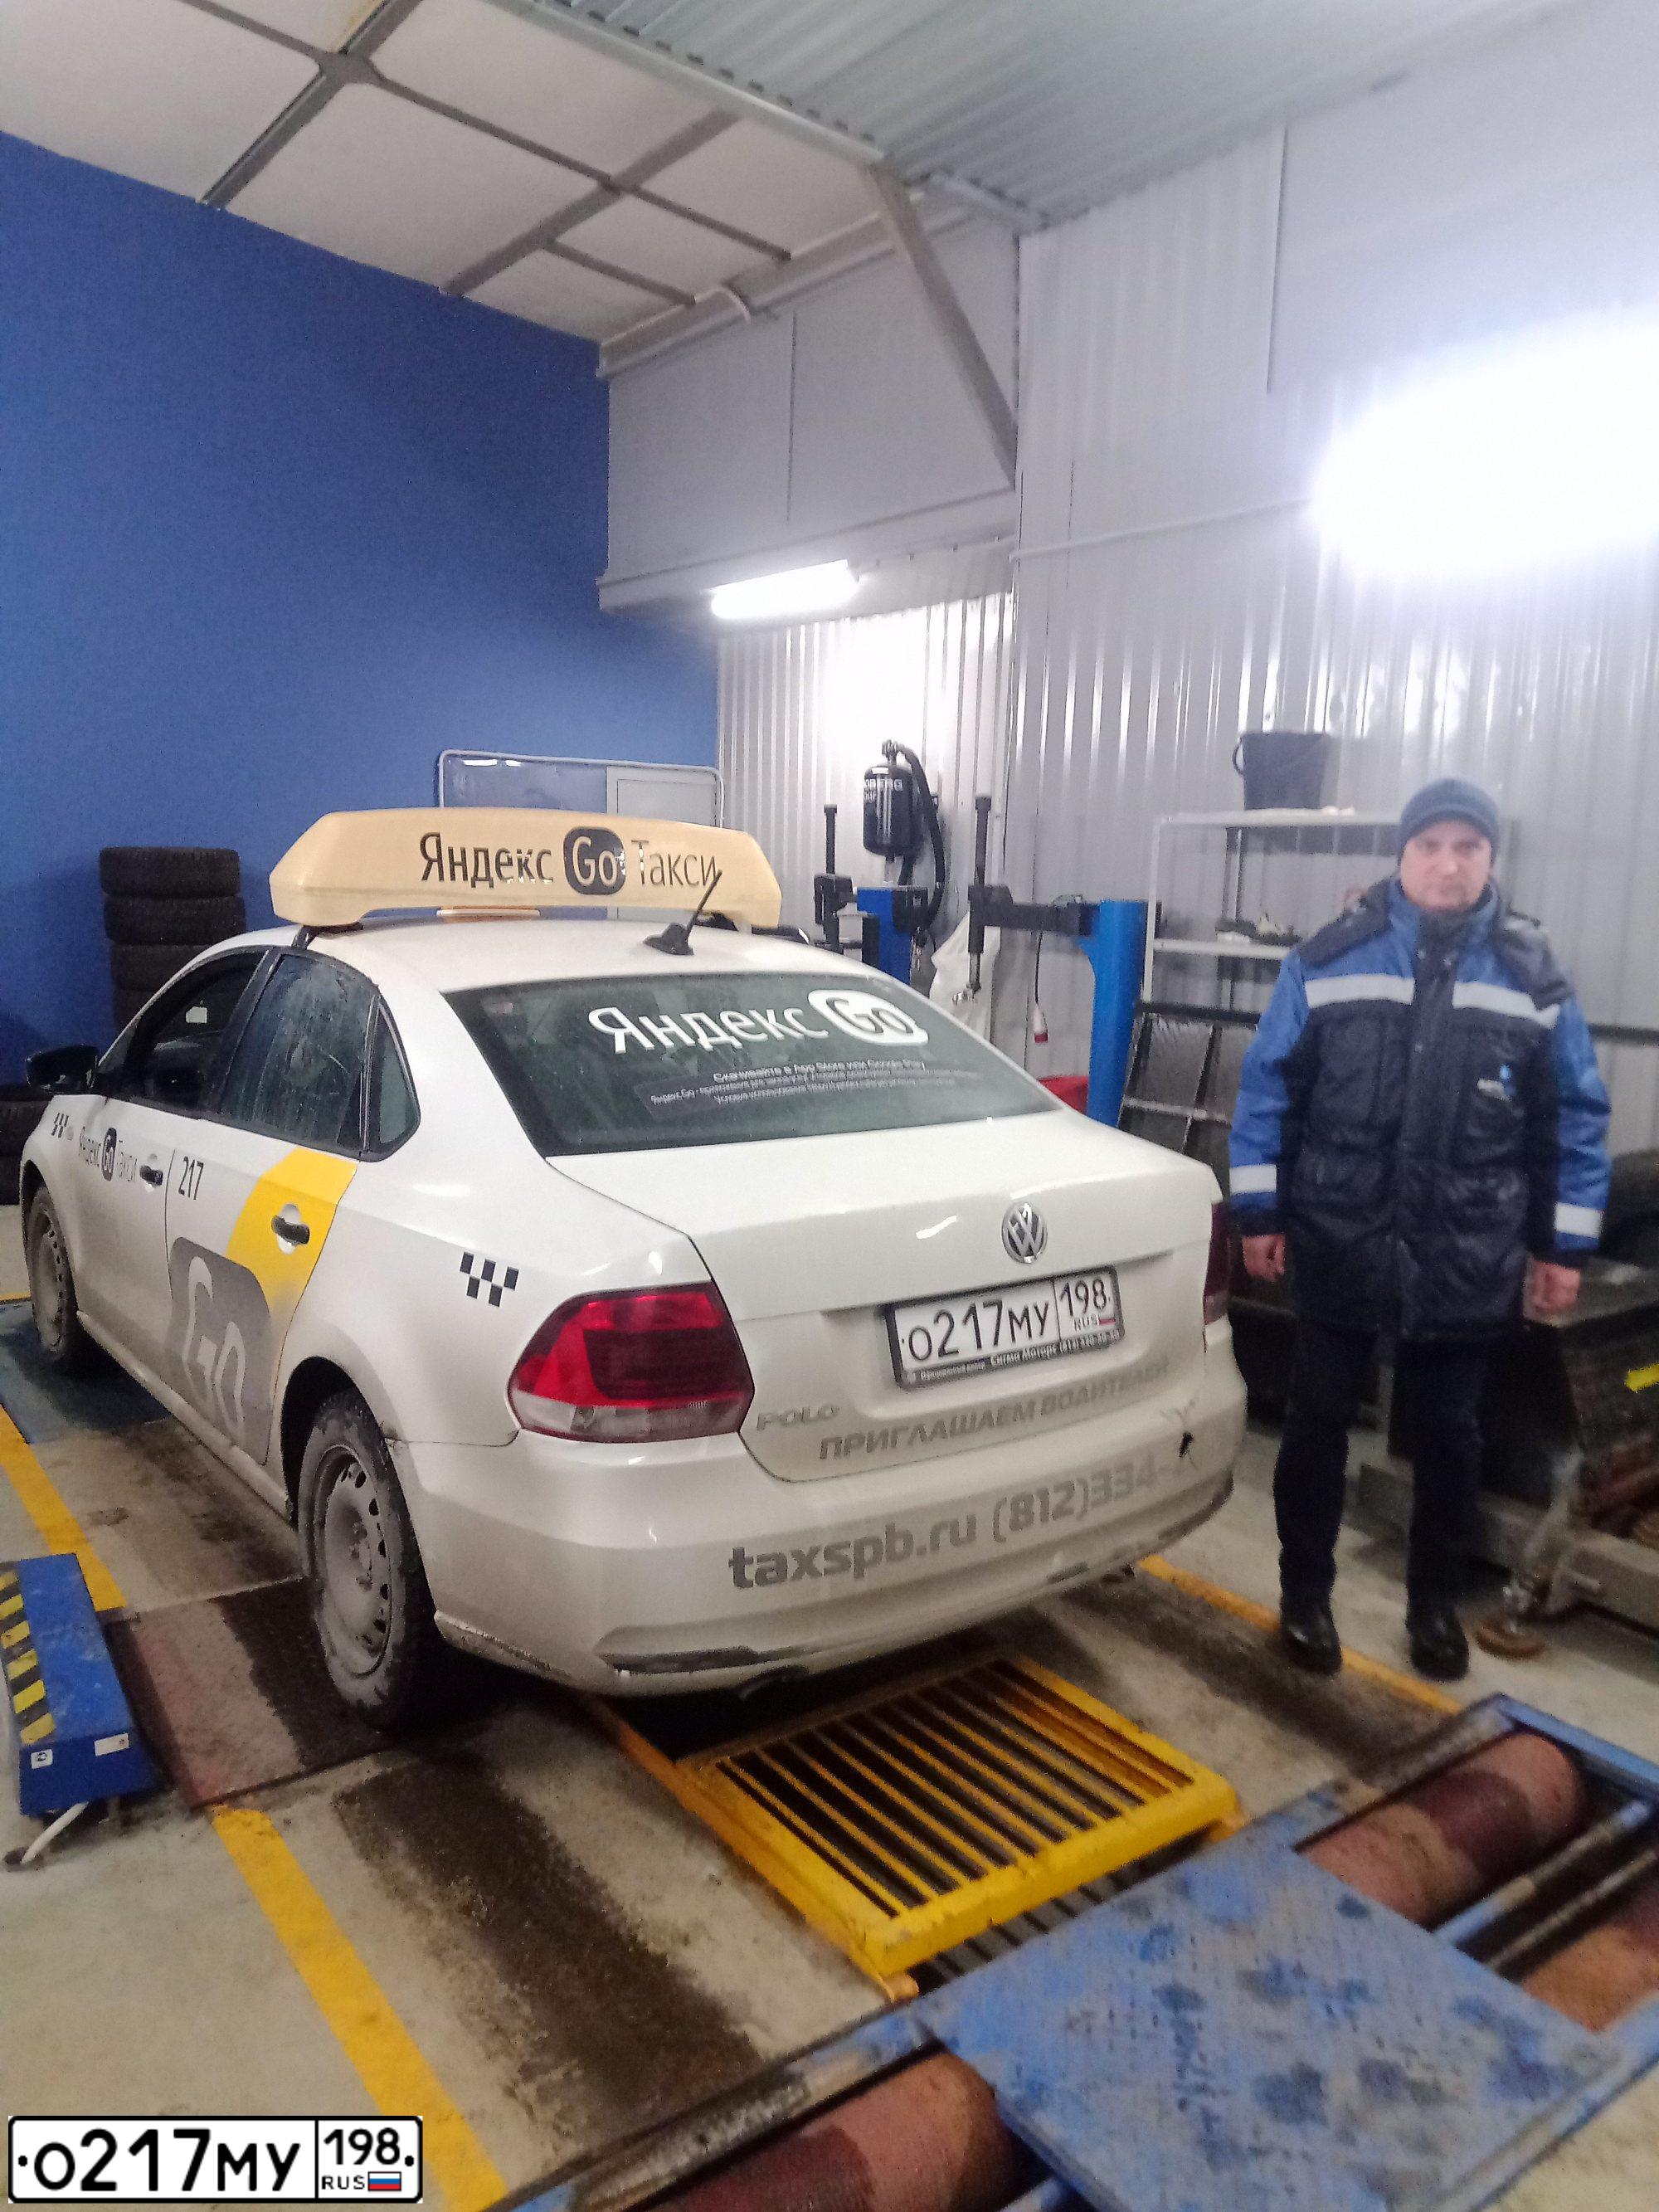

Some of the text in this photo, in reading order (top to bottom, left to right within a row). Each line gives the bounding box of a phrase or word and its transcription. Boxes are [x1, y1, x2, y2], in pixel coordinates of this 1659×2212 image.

[419, 831, 723, 889] Яндекс Go Такси
[587, 996, 915, 1054] Яндекс Go
[178, 1155, 205, 1201] 217
[1059, 1278, 1107, 1318] 198
[756, 1404, 839, 1431] POLO
[819, 1398, 1037, 1460] ПРИГЛАШАЕМ
[727, 1513, 978, 1590] taxspb.ru
